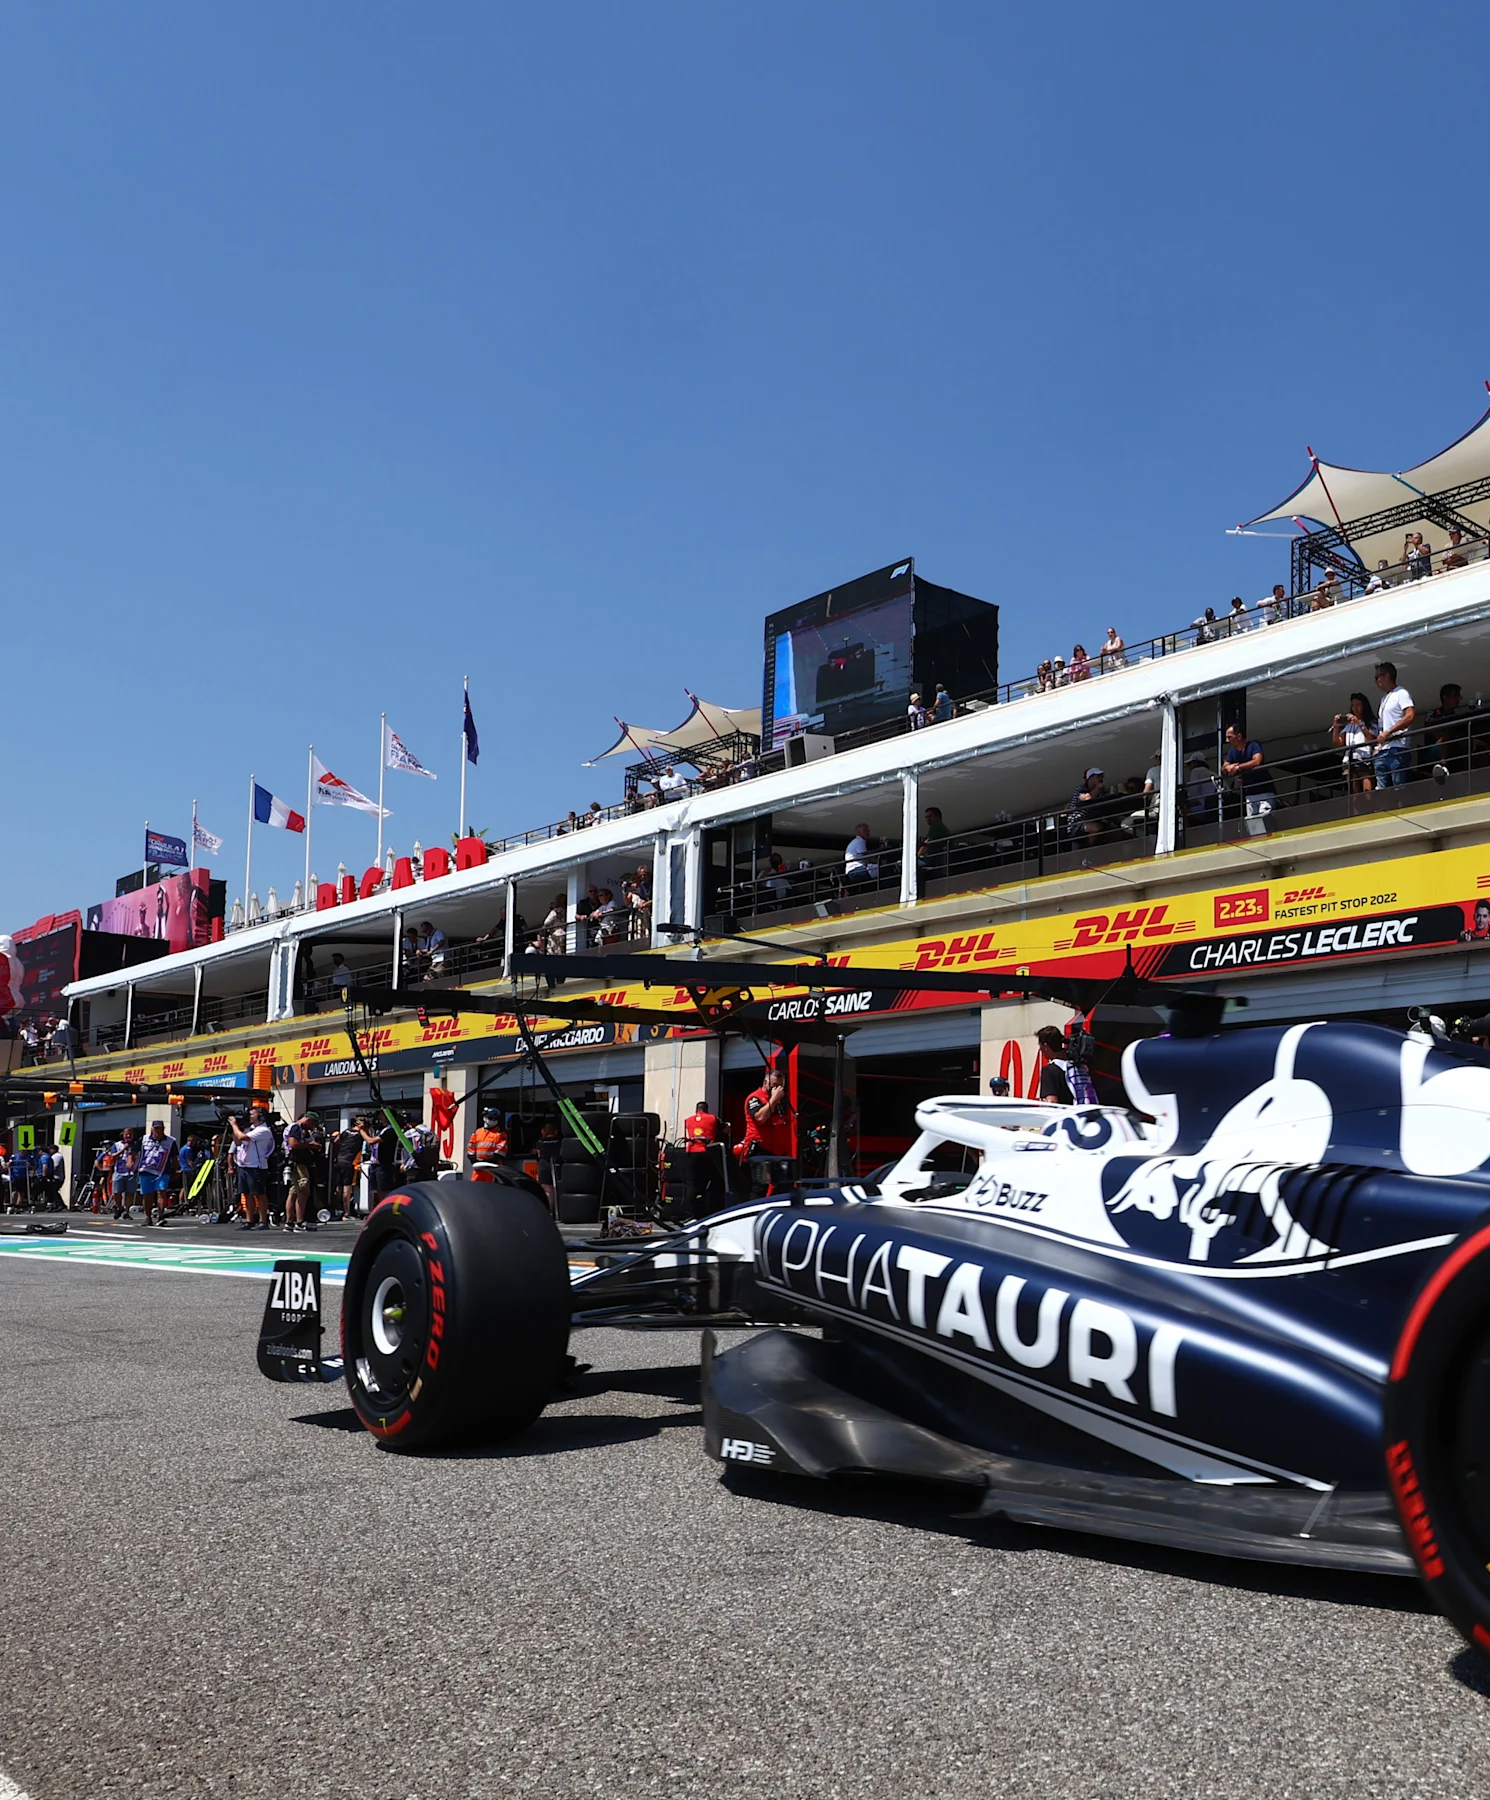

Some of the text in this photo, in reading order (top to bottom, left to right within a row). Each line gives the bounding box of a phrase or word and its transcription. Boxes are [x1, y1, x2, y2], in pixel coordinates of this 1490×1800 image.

[1274, 893, 1397, 920] FASTEST PIT STOP 2022
[1282, 886, 1328, 904] DHL
[1219, 897, 1264, 920] 2.23s
[1071, 905, 1176, 949] DHL
[914, 932, 1001, 970] DHL
[1190, 917, 1419, 970] CHARLES LECLERC
[825, 991, 872, 1014] SAINZ
[422, 1018, 462, 1042] DHL
[249, 1047, 277, 1066] DHL
[300, 1039, 331, 1059] DHL
[162, 1062, 185, 1080] DHL
[203, 1055, 229, 1073] DHL
[270, 1271, 318, 1312] ZIBA
[420, 1232, 447, 1372] P ZERO
